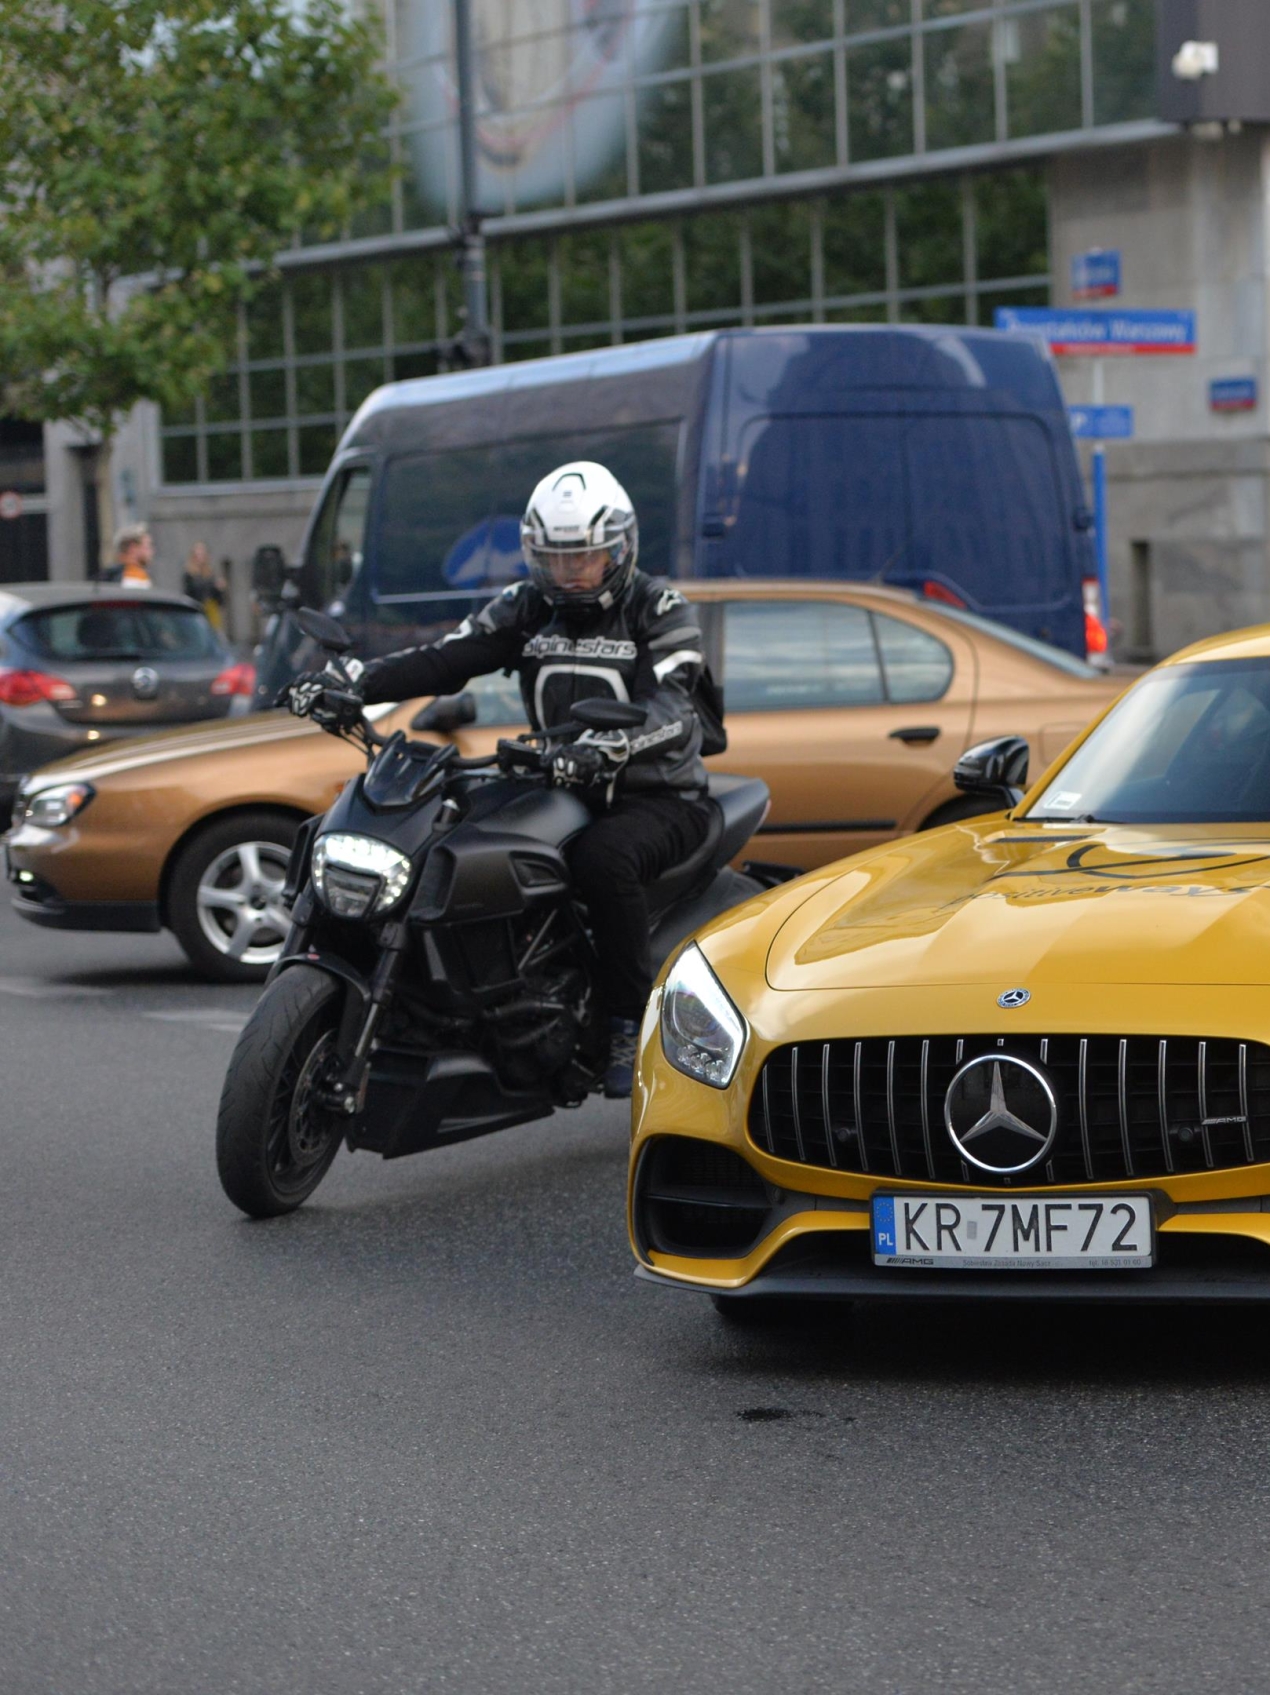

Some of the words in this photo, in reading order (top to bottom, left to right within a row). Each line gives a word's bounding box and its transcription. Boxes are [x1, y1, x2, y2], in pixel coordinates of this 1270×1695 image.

[903, 1202, 962, 1252] KR
[981, 1202, 1138, 1252] 7MF72
[878, 1233, 894, 1246] PL
[902, 1257, 934, 1265] AMG
